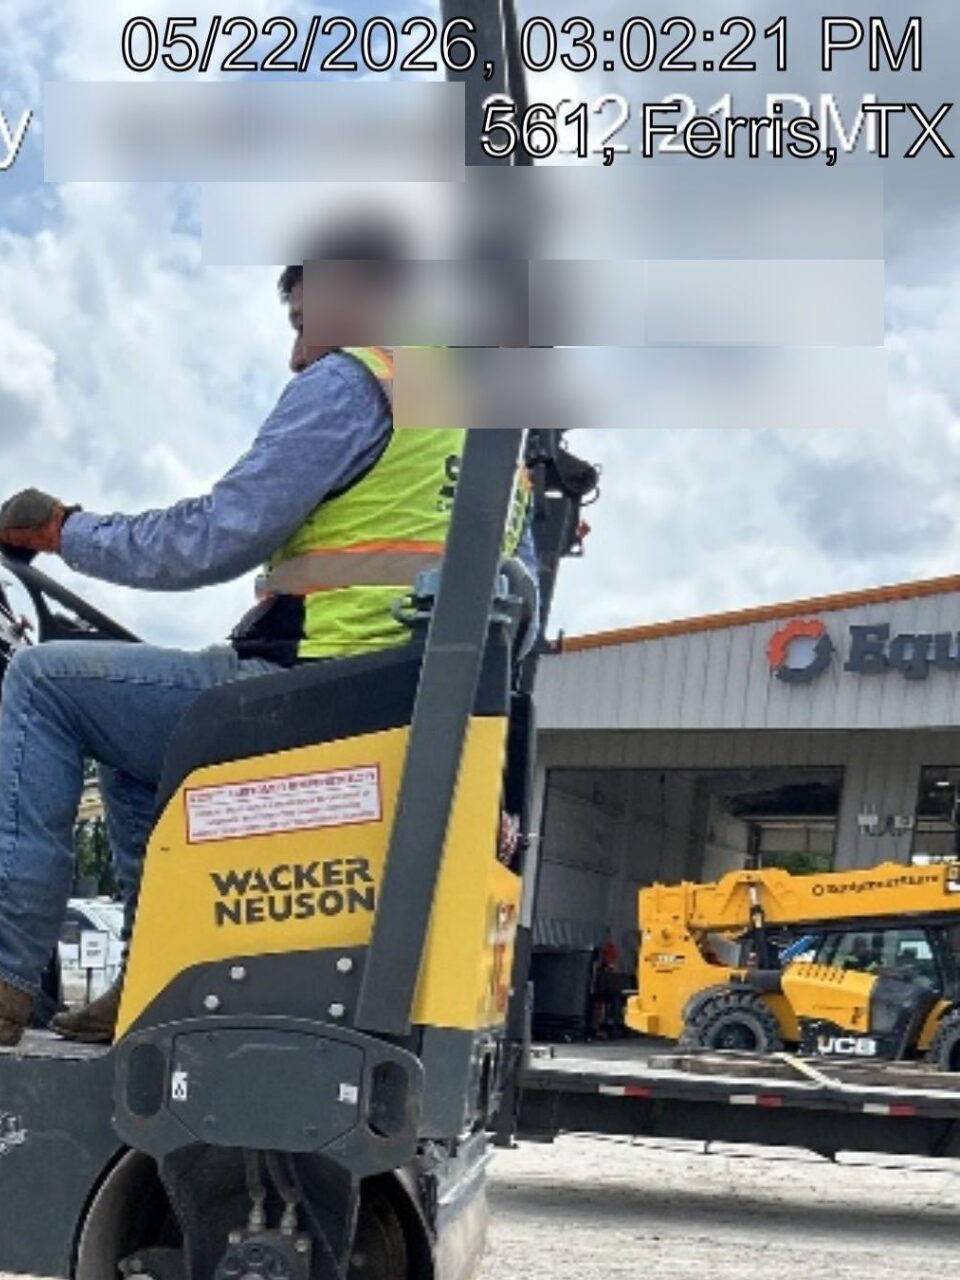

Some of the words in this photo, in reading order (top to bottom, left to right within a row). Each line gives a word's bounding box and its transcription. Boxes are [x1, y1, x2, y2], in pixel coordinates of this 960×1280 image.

[209, 857, 375, 897] WACKER
[214, 887, 376, 926] NEUSON
[817, 1036, 876, 1055] JCB
